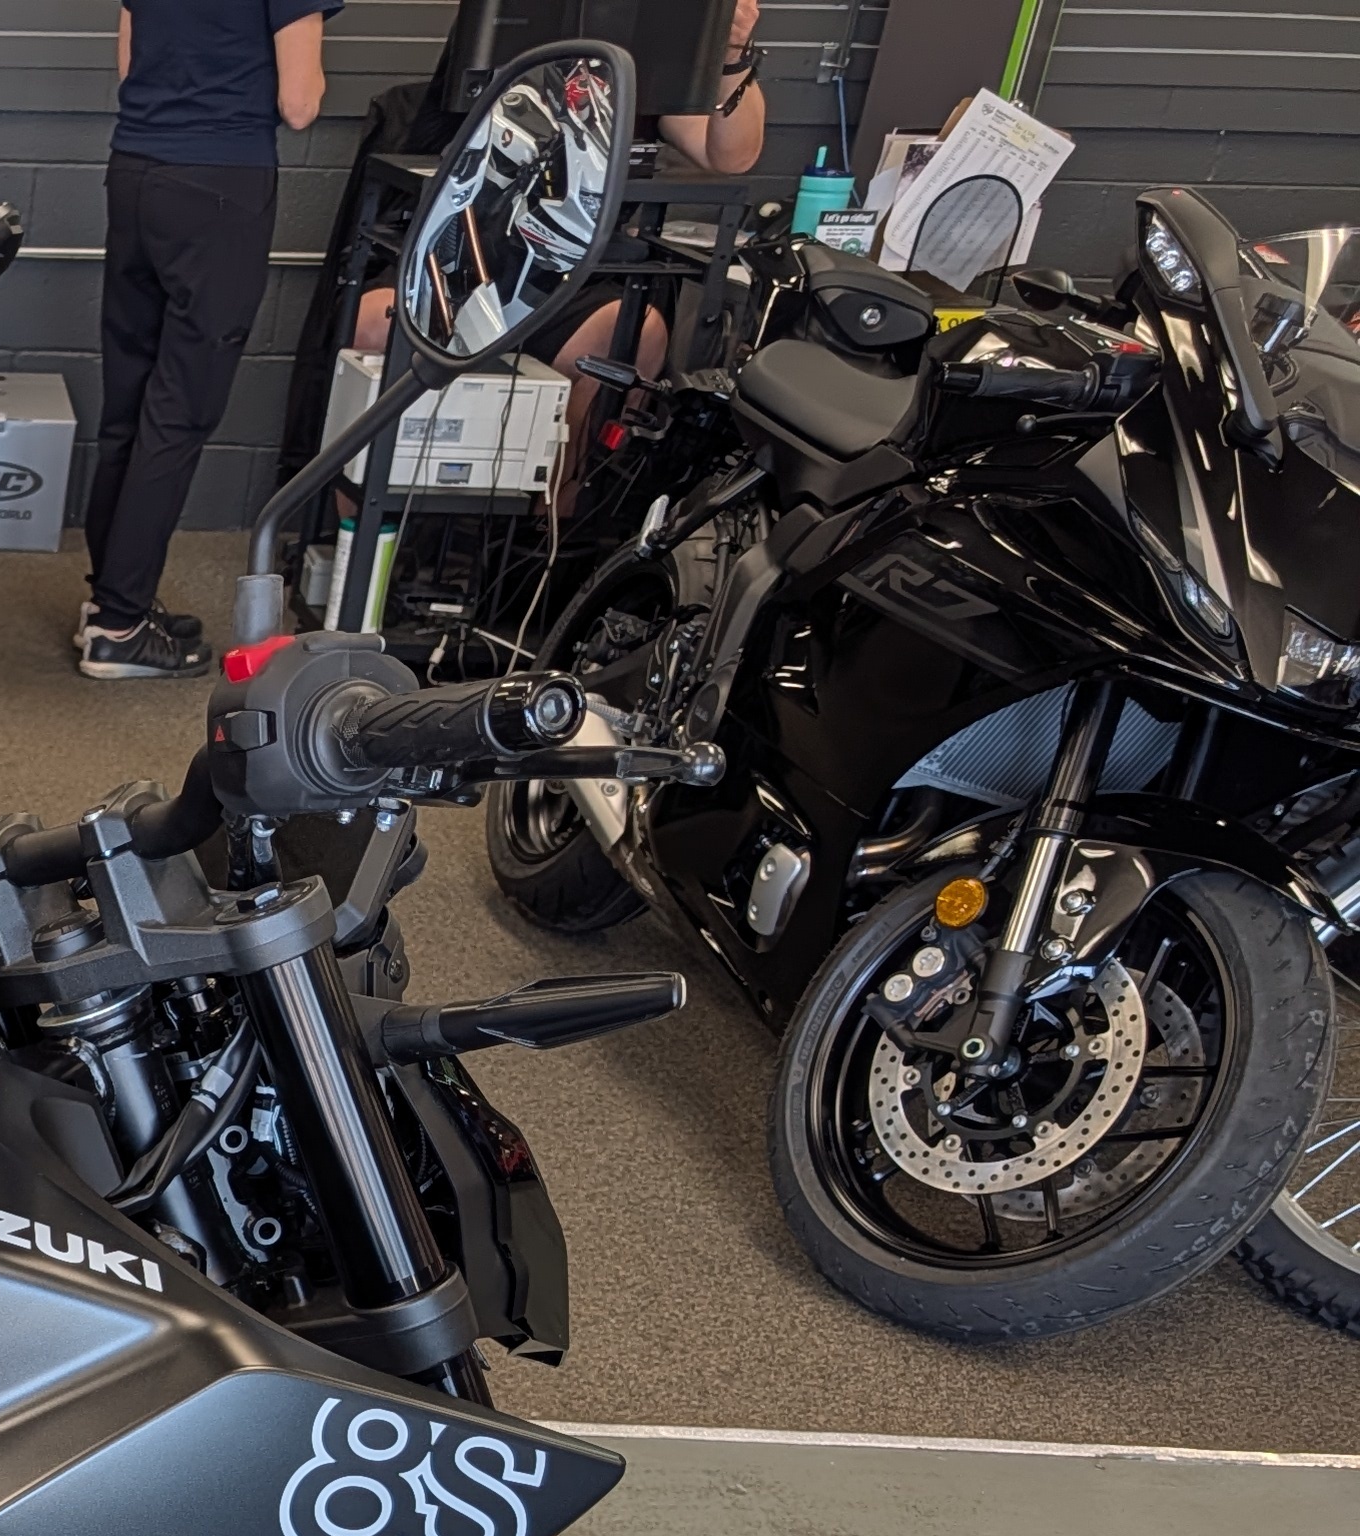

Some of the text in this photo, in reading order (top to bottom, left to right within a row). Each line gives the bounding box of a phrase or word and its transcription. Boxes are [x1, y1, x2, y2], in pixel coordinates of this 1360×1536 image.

[823, 213, 839, 223] Let's
[840, 214, 849, 224] go
[856, 553, 1000, 621] R7
